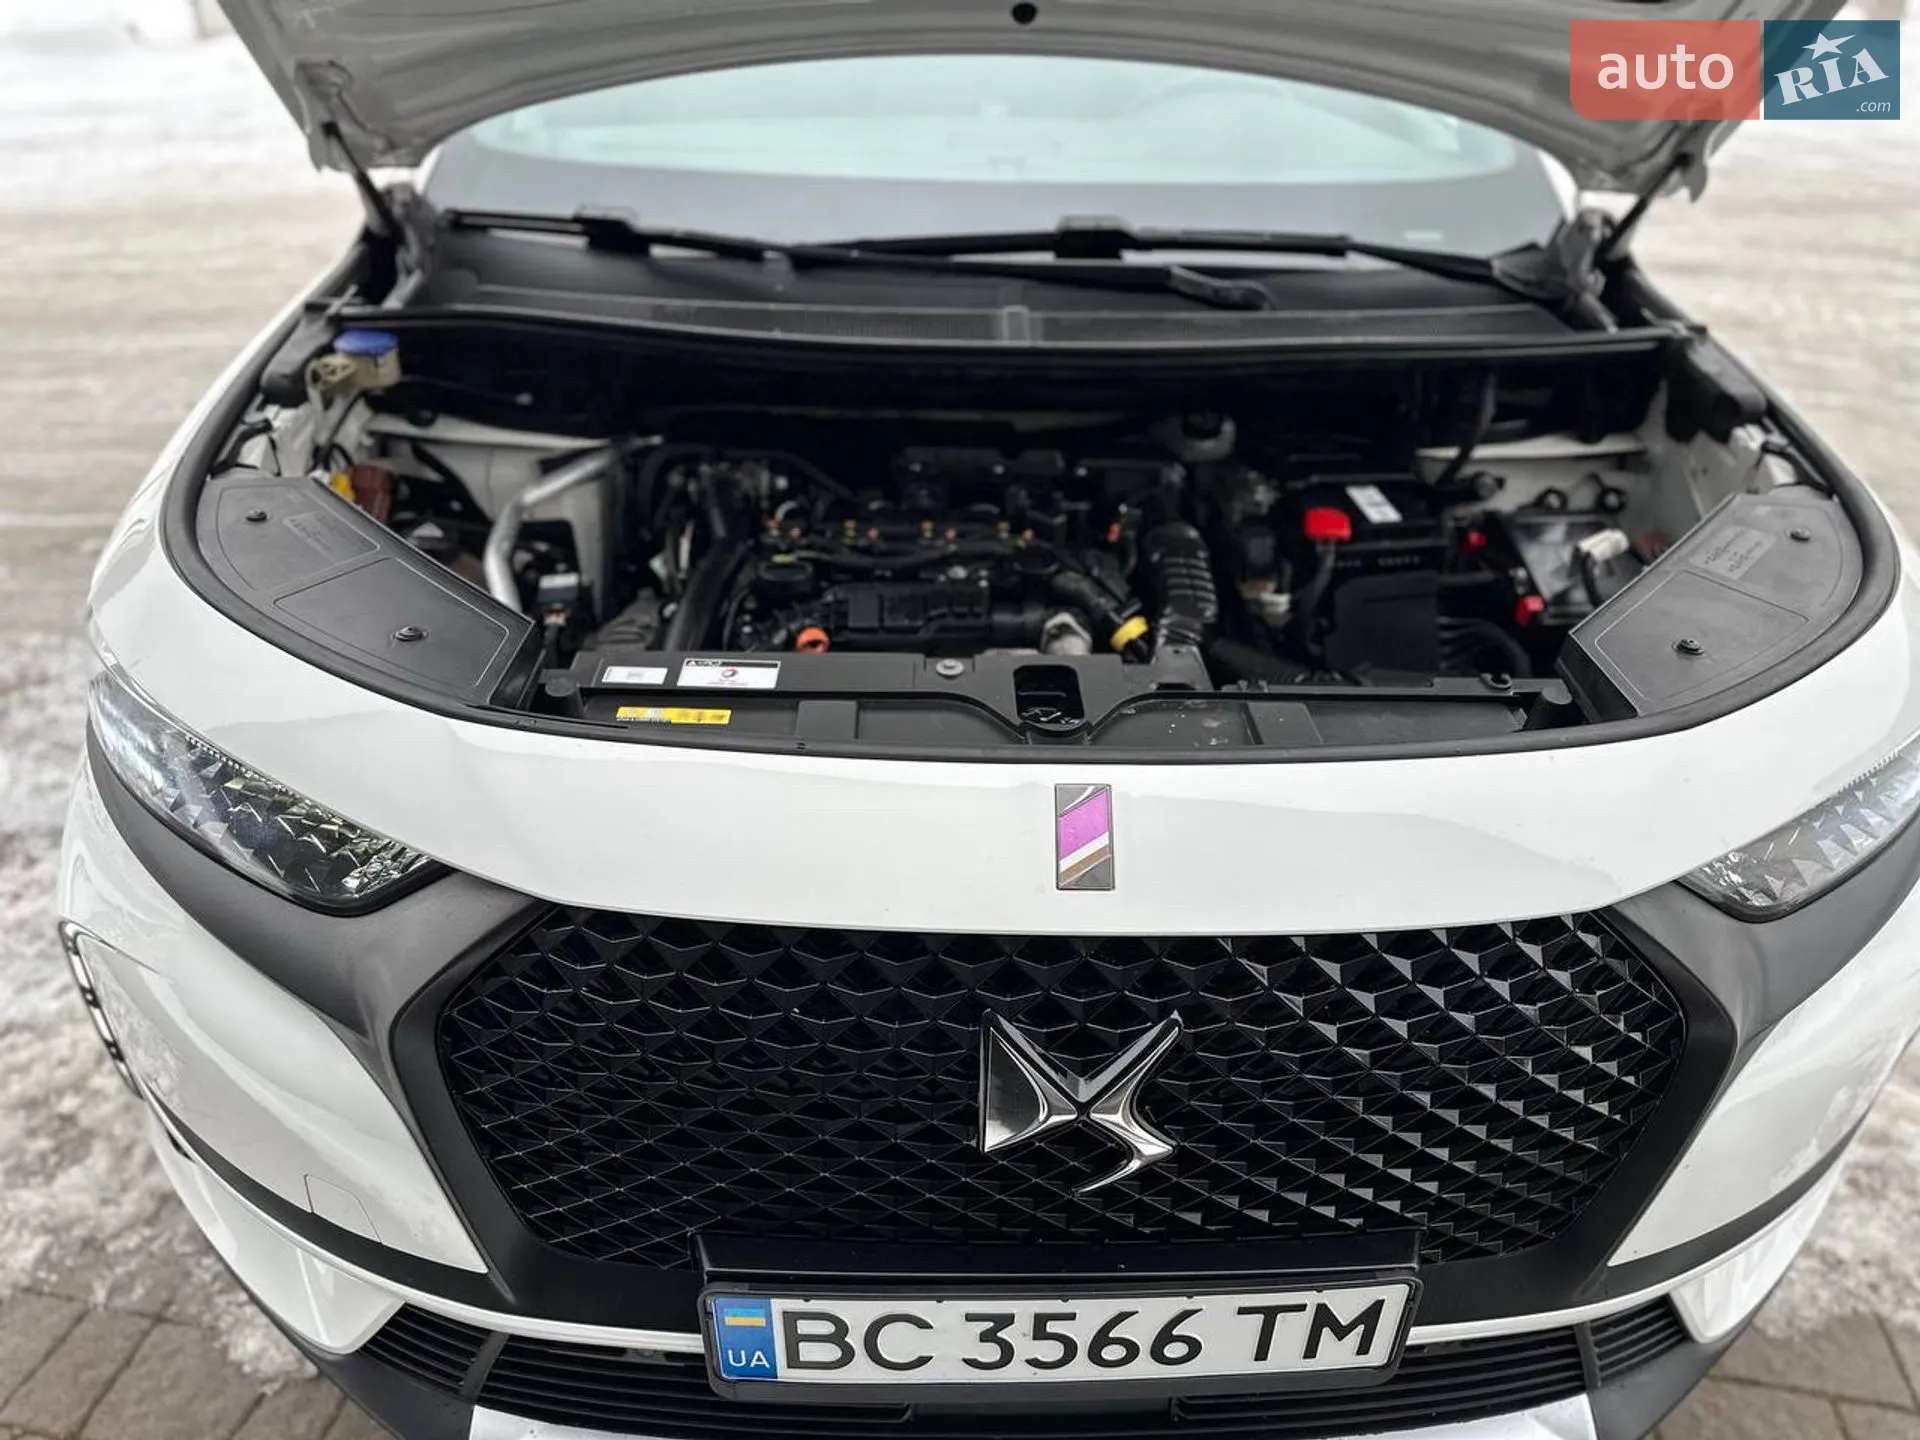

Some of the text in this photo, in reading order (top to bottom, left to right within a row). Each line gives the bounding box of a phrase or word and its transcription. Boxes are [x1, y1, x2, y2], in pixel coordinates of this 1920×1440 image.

[782, 1299, 1385, 1371] BC 3566 TM
[728, 1349, 770, 1368] UA
